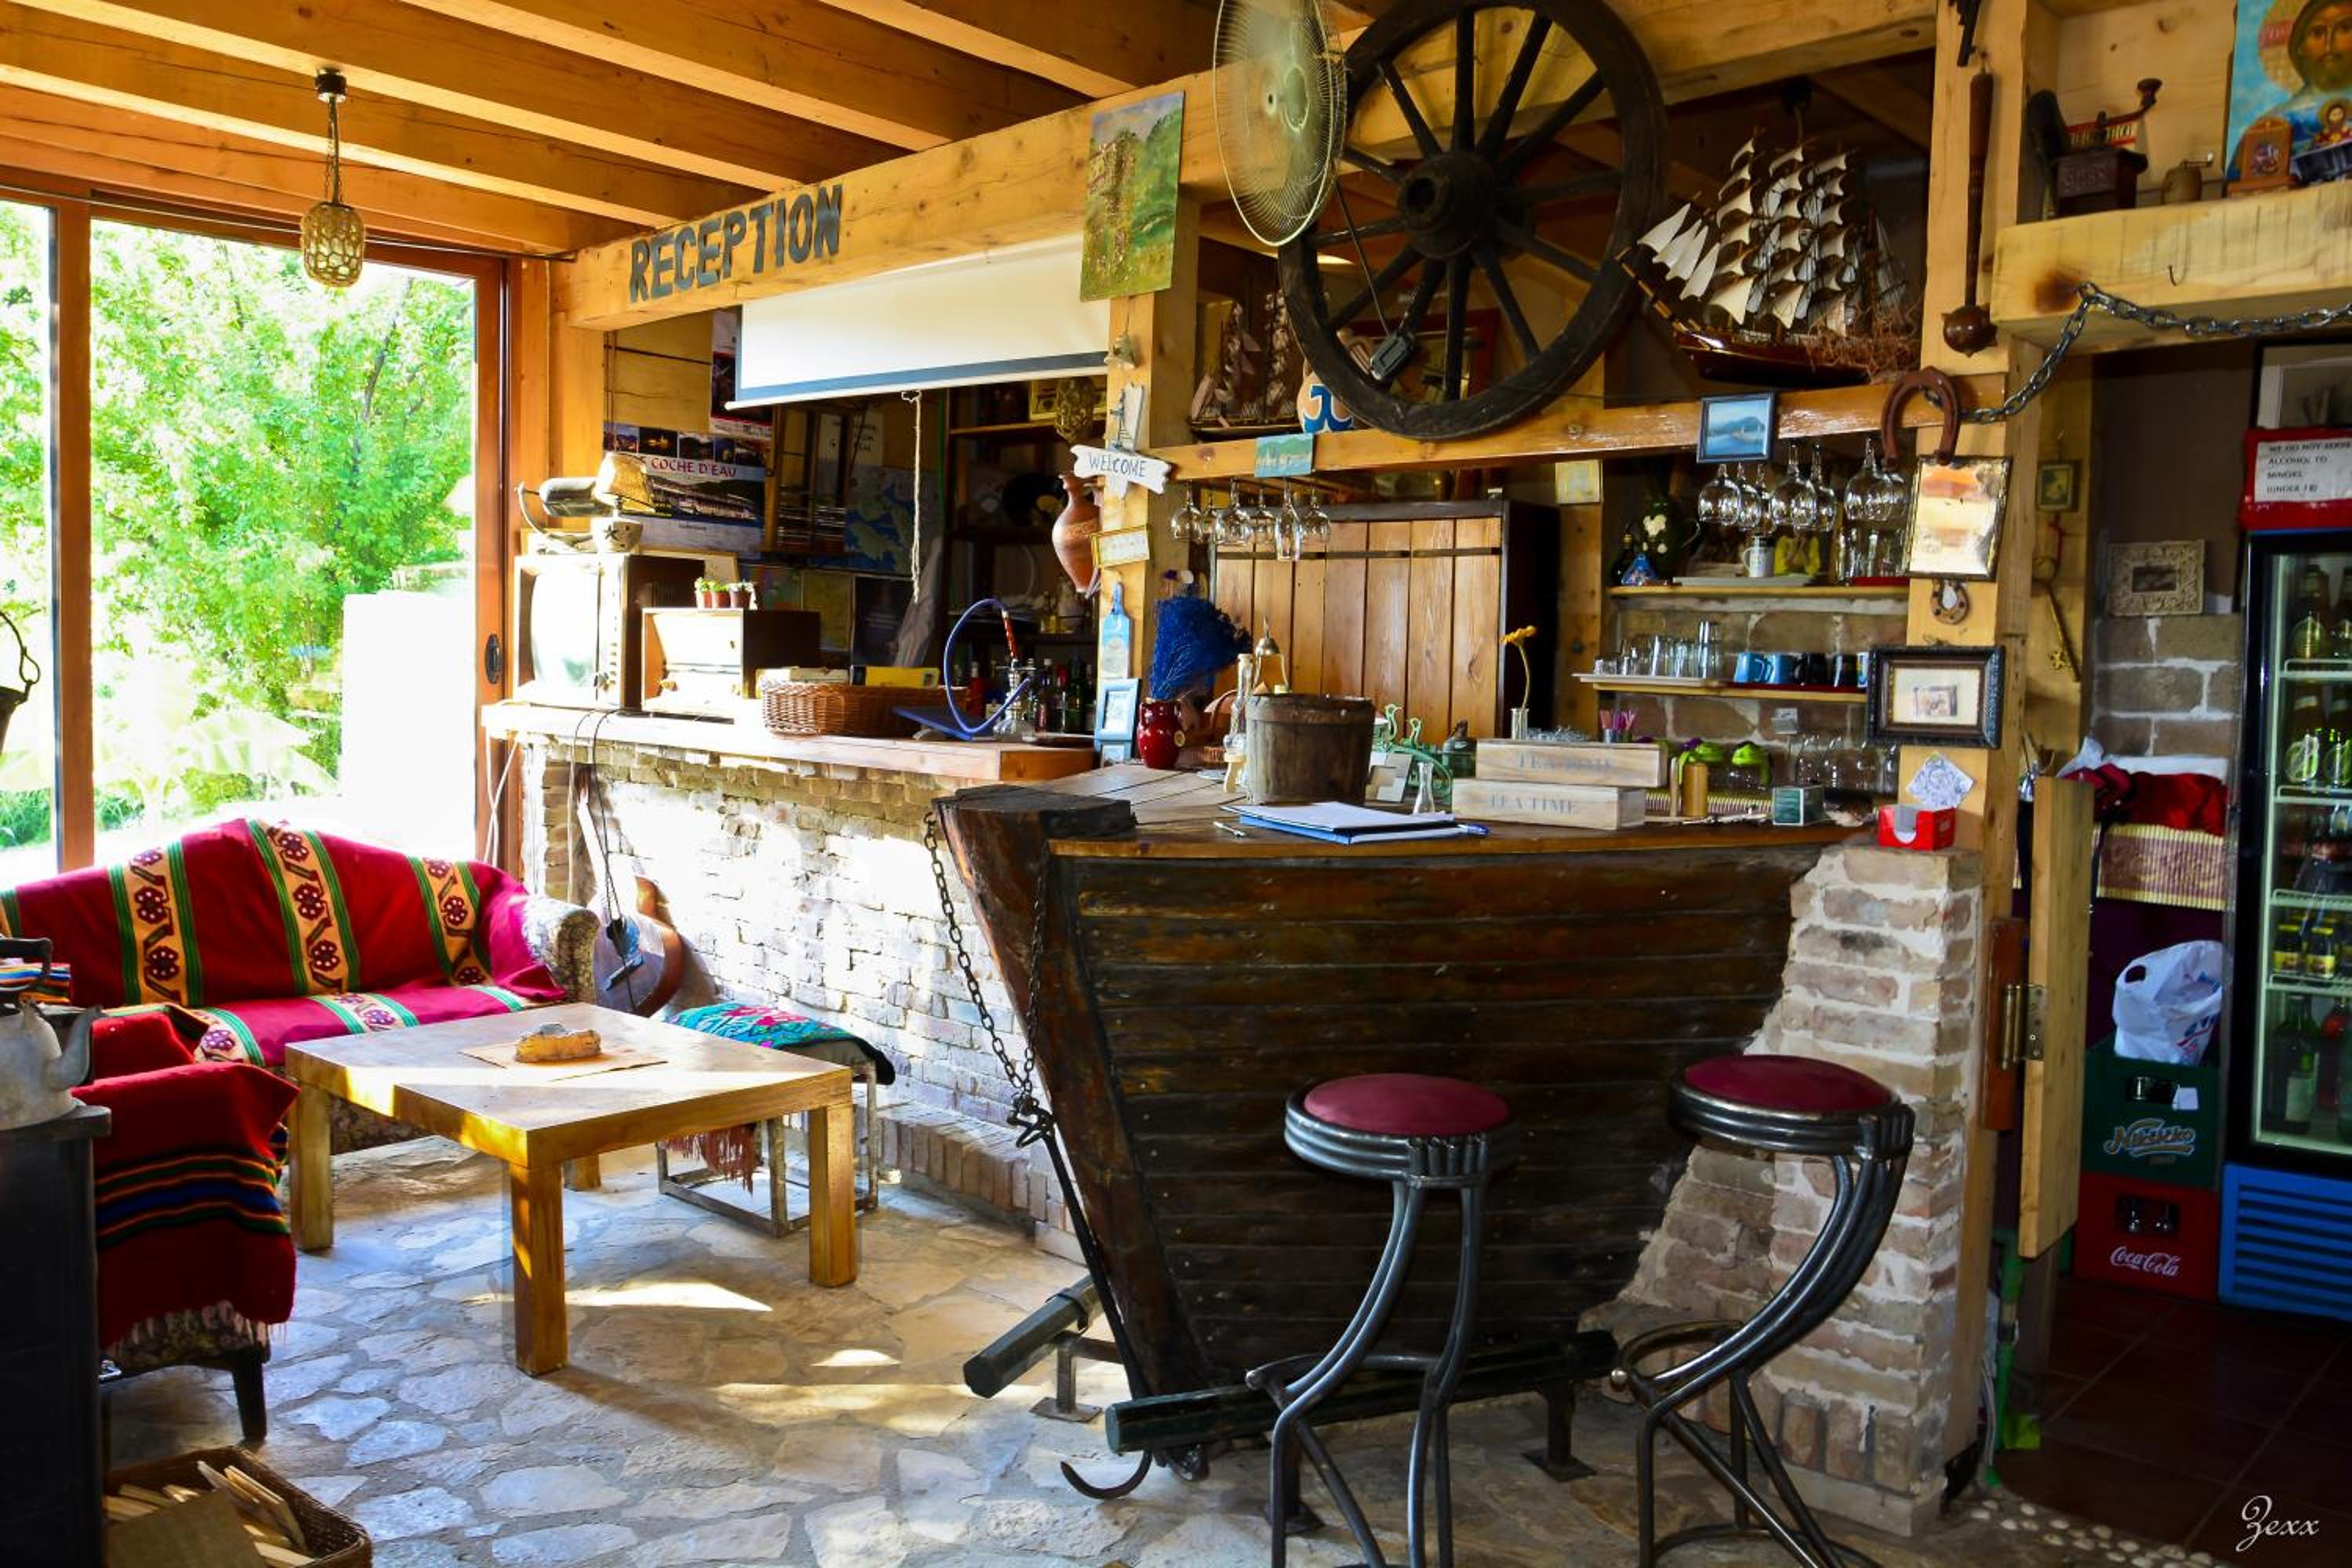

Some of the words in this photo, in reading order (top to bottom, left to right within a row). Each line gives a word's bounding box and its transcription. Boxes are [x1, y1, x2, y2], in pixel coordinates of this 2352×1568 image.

[630, 184, 843, 302] RECEPTION
[652, 457, 694, 473] COCHE
[699, 463, 737, 477] D'EAU
[1088, 452, 1146, 477] WELCOME
[1530, 796, 1579, 816] TIME
[2110, 1246, 2181, 1277] Coca-Cola
